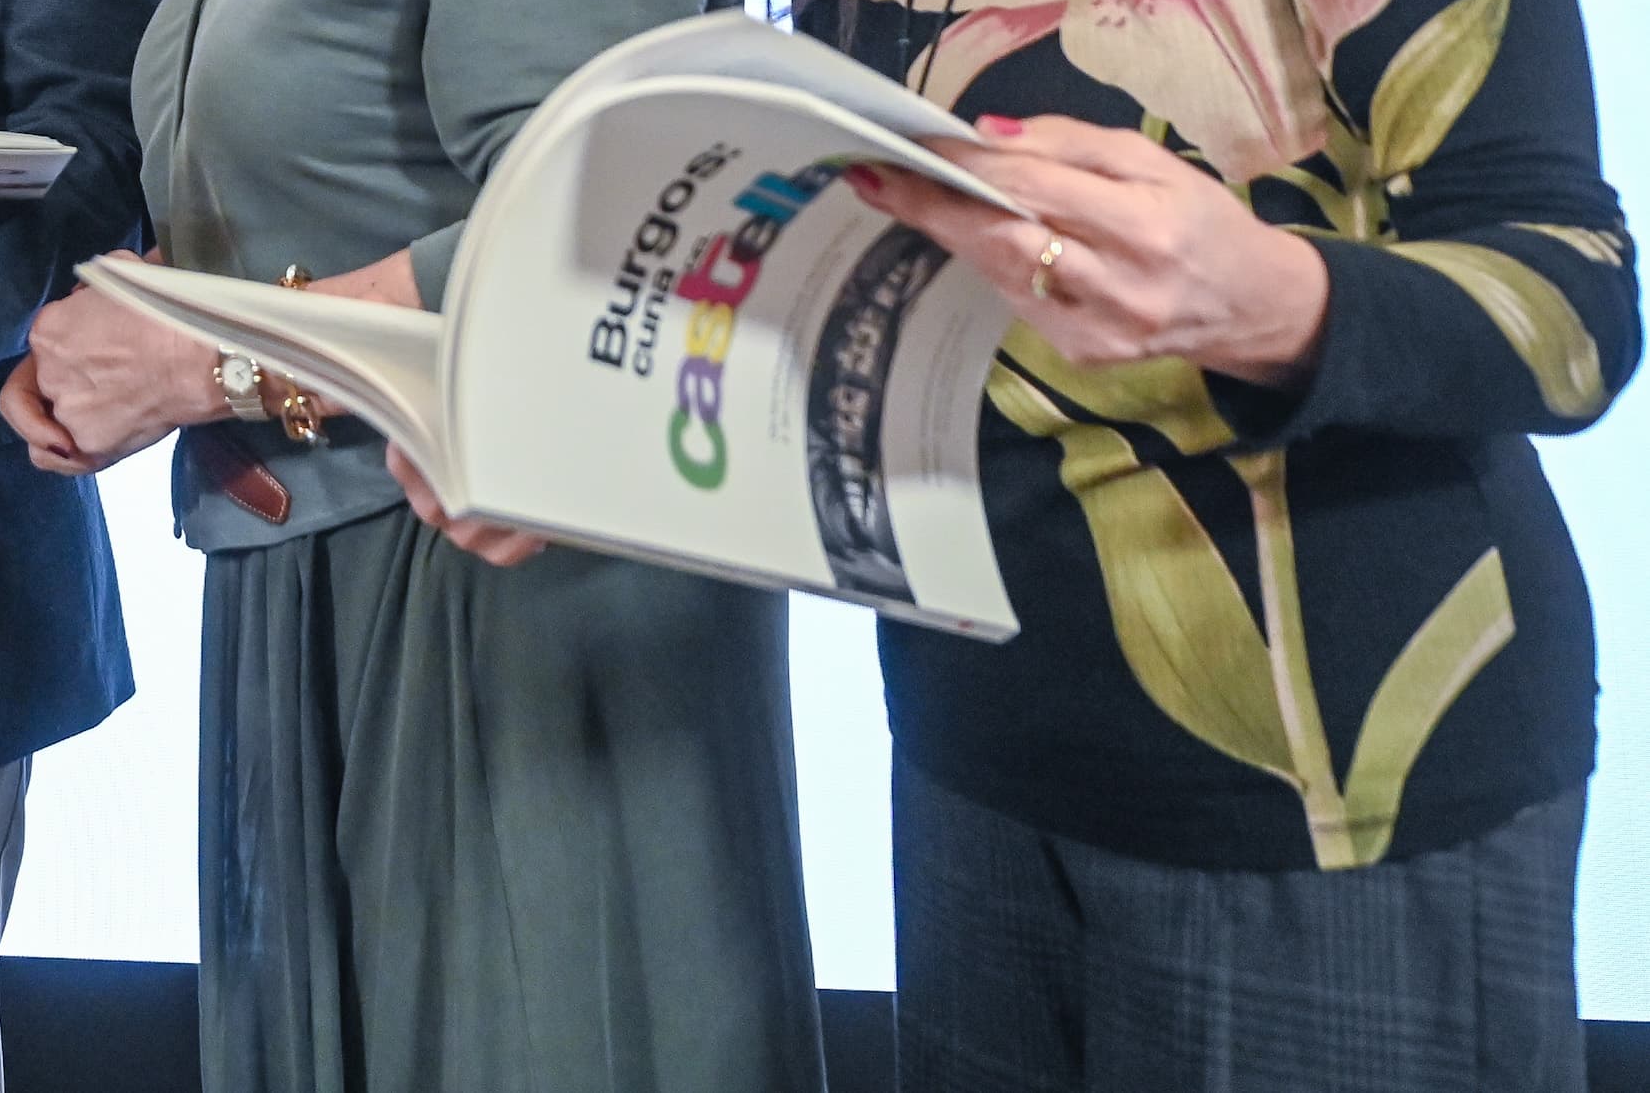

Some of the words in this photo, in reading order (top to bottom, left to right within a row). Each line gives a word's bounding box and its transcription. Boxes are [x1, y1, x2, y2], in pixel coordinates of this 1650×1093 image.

[587, 141, 741, 370] Burgos:
[632, 267, 676, 380] cuna
[666, 153, 850, 492] castella
